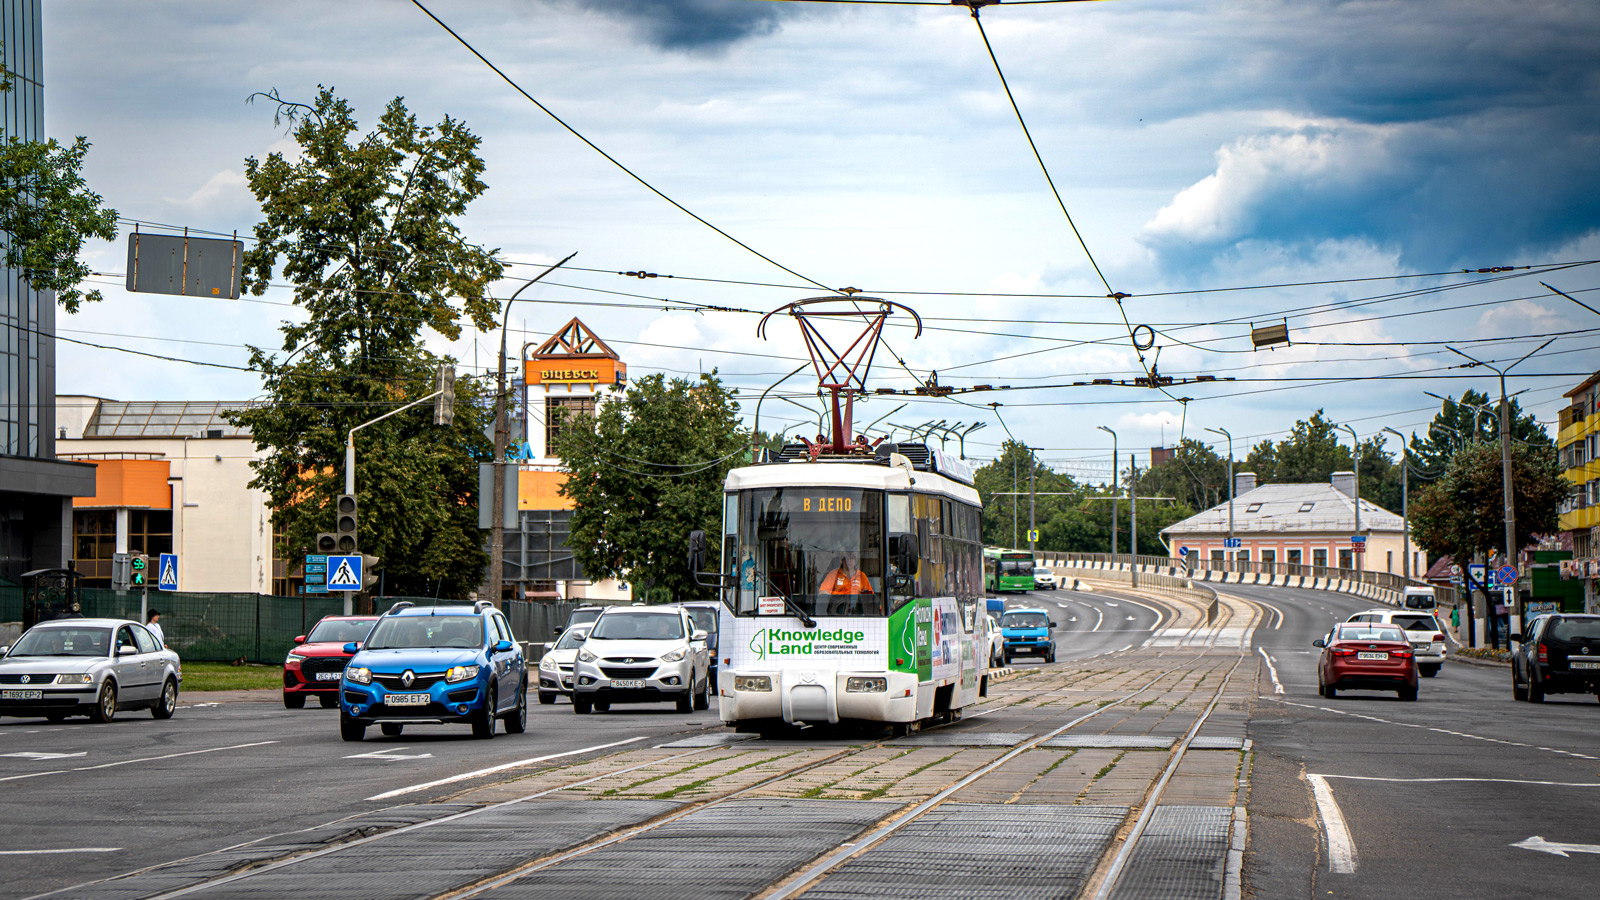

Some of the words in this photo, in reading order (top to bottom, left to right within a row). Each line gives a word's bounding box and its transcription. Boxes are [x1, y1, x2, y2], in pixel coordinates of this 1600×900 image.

[803, 497, 811, 512] В
[818, 497, 852, 513] ДЕПО
[768, 628, 864, 643] Knowledge
[768, 642, 813, 655] Land
[391, 695, 409, 704] 0985
[410, 694, 429, 703] ET-2
